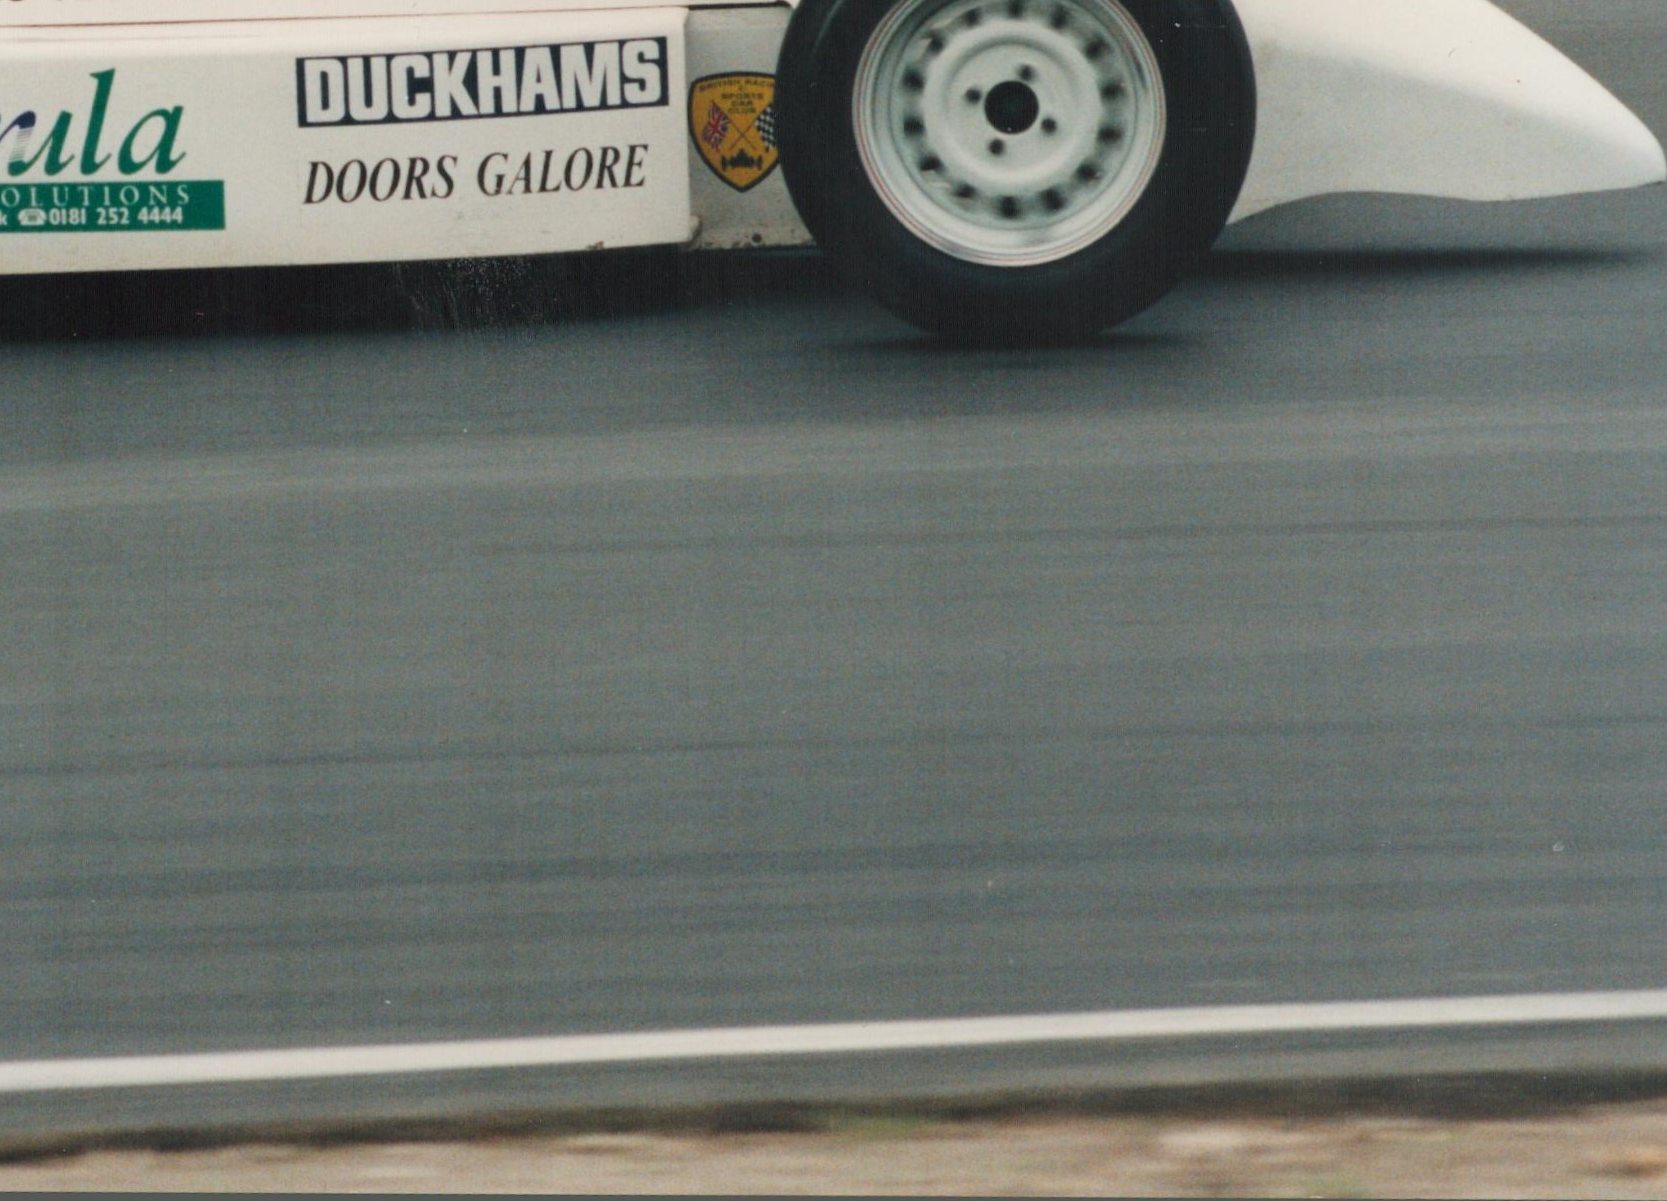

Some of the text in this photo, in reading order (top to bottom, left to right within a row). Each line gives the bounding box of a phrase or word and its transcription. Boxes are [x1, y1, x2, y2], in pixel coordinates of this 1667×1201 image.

[302, 38, 664, 124] DUCKHAMS
[302, 143, 650, 205] DOORS GALORE
[96, 207, 131, 225] 252
[137, 206, 184, 225] 4444
